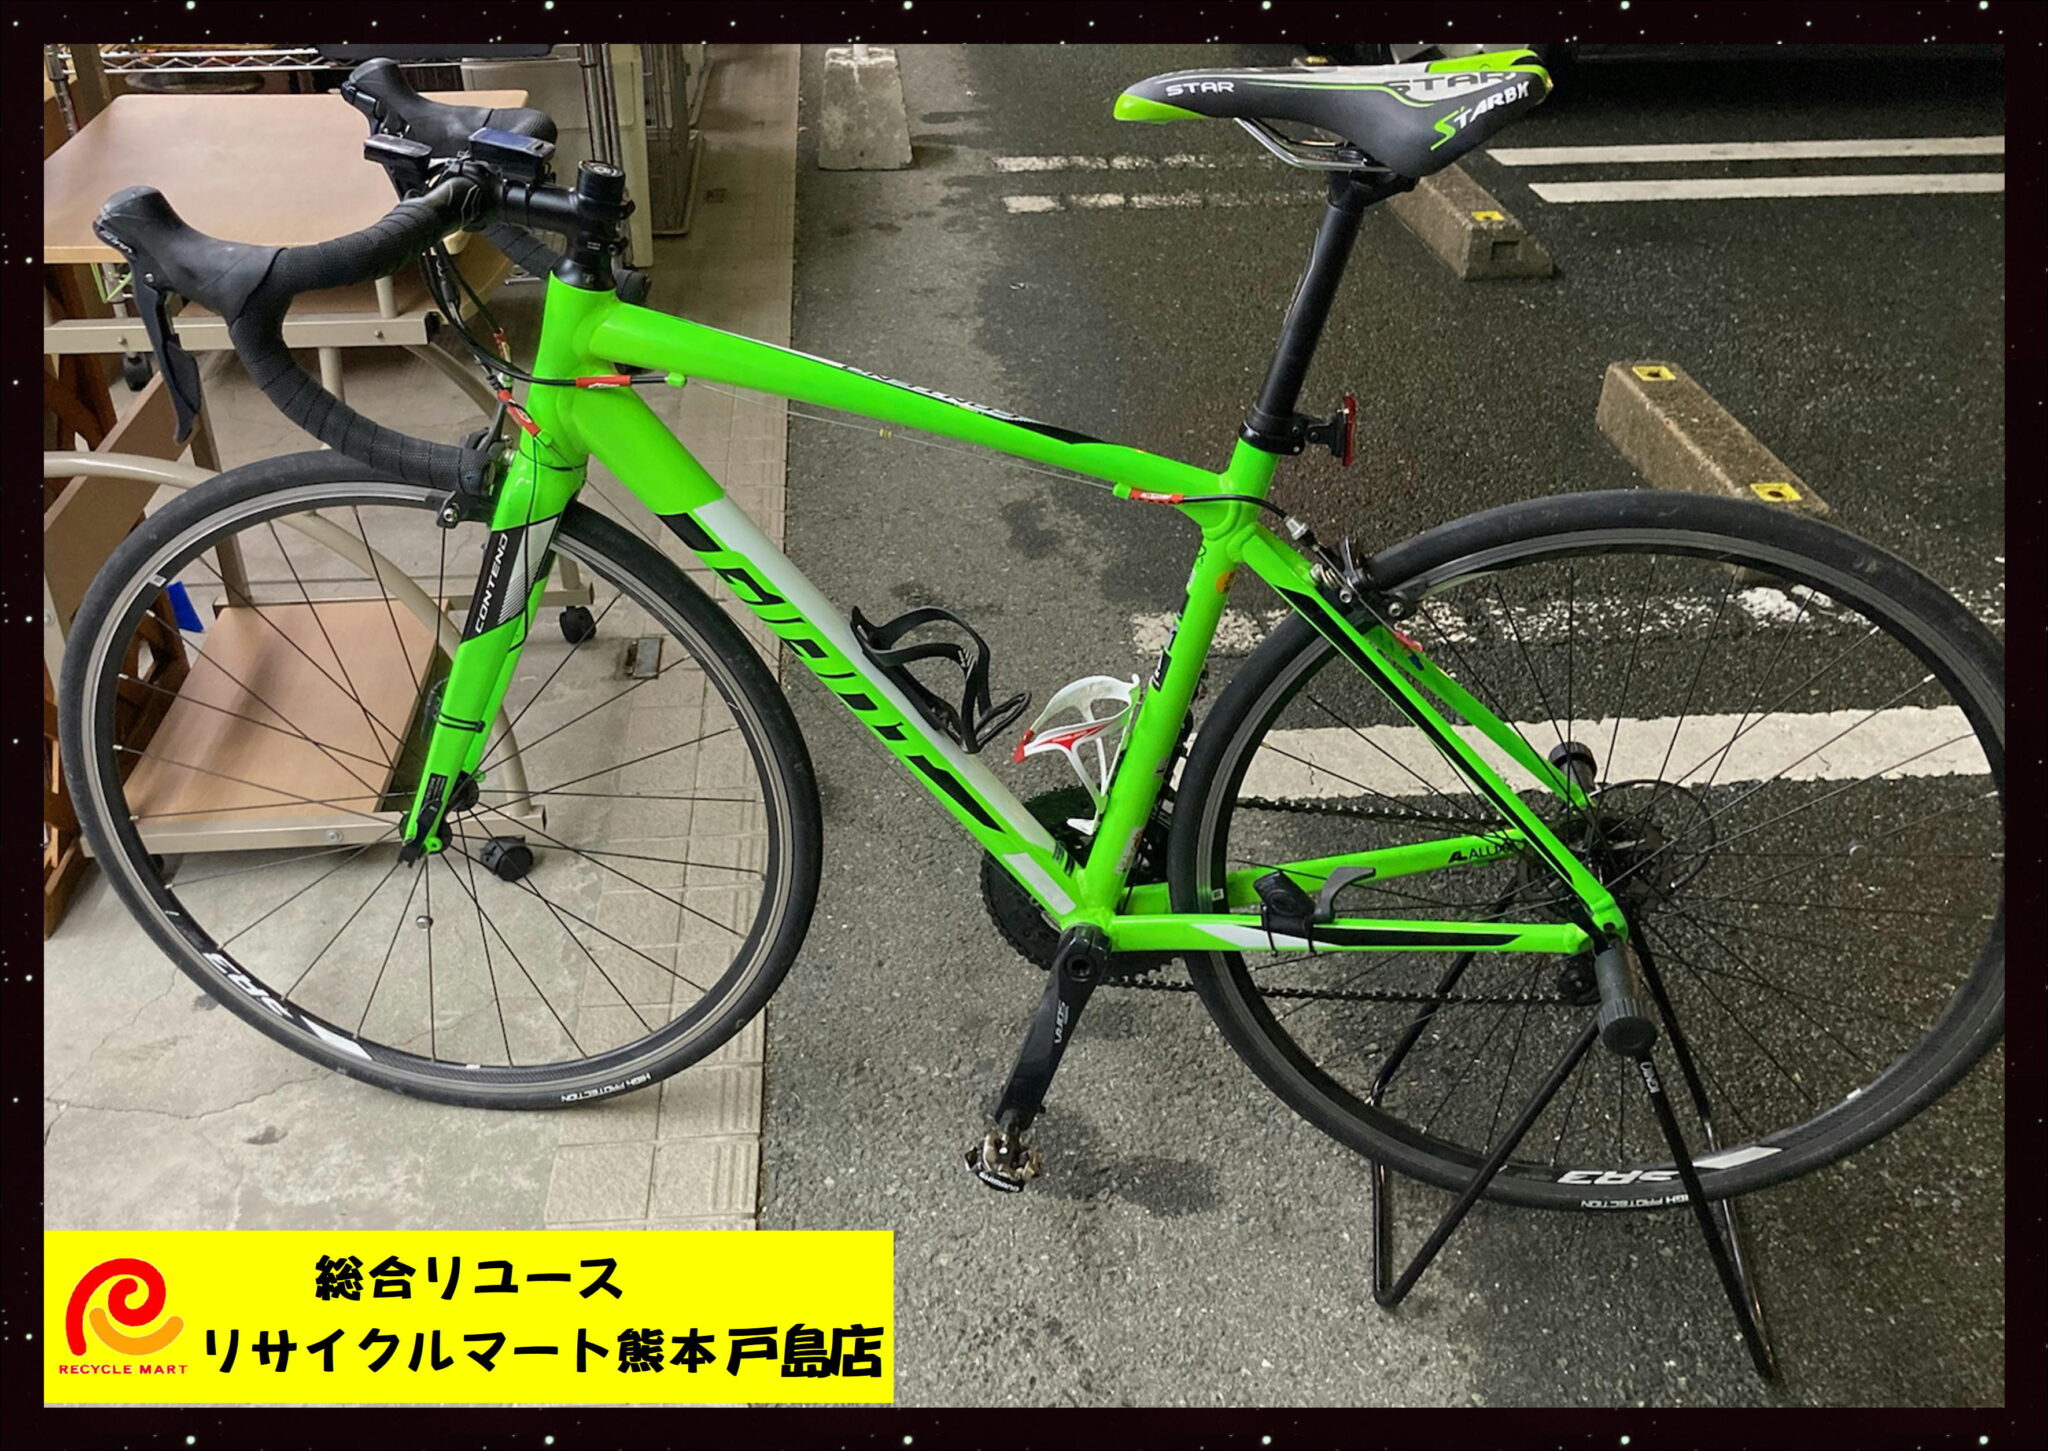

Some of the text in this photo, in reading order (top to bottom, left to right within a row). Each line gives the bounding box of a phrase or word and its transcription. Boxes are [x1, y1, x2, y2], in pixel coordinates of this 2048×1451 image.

[1165, 81, 1235, 97] STAR
[475, 532, 509, 634] CONTEND
[561, 1083, 626, 1103] PROTECTION
[1580, 1196, 1664, 1209] PROTECTION
